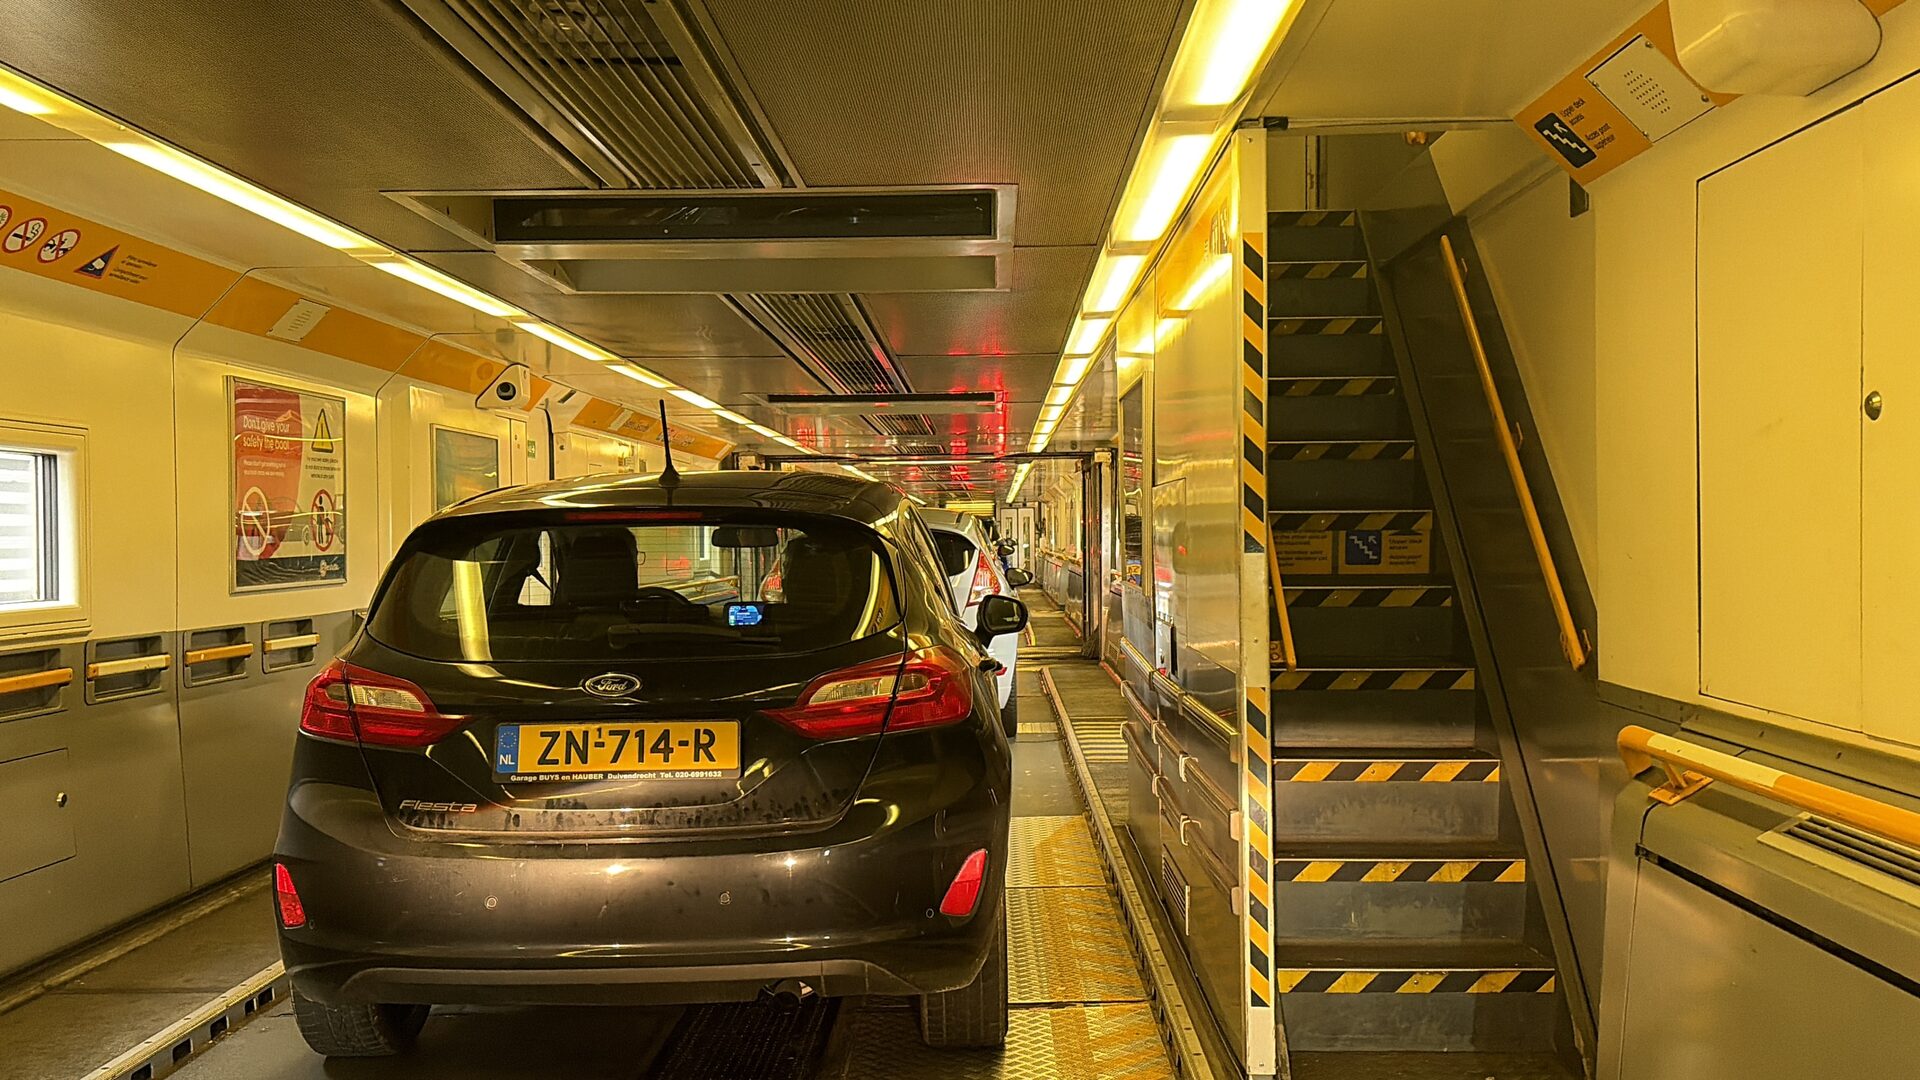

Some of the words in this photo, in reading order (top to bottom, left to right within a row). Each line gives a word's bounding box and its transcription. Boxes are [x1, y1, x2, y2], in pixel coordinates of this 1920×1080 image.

[260, 419, 274, 433] give
[275, 421, 290, 434] your
[243, 434, 263, 451] safety
[592, 679, 629, 690] Ford
[499, 754, 516, 766] NL
[537, 728, 717, 766] ZN-714-R
[400, 800, 477, 813] Fiesta
